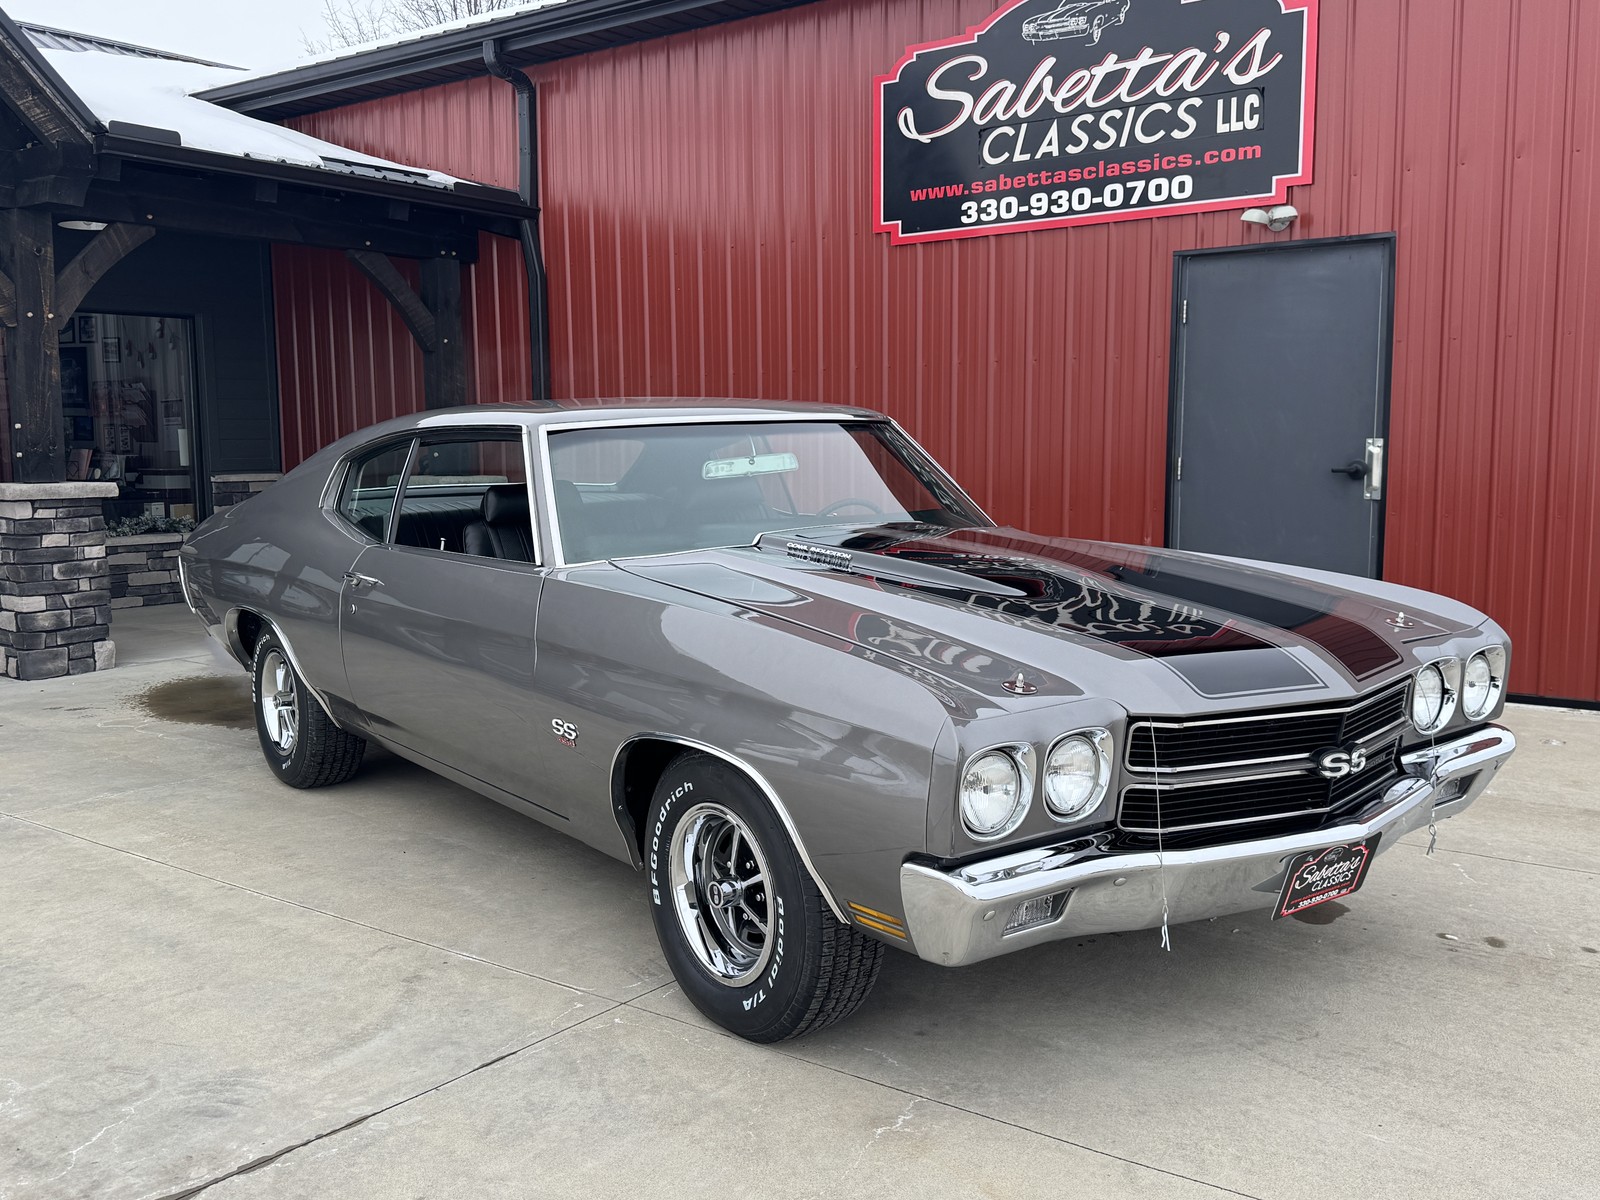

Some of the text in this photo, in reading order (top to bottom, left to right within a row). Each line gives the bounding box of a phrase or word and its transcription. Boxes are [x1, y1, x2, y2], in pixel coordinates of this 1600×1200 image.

[898, 27, 1284, 143] Sabetta's
[982, 93, 1261, 165] CLASSICS LLC
[910, 144, 1262, 202] www.sabettasclassics.com
[960, 174, 1193, 224] 330-930-0700
[786, 542, 851, 558] COWL INDUCTION
[551, 718, 577, 740] SS
[1320, 748, 1367, 778] SS
[651, 781, 694, 906] BFGoodrich
[1294, 856, 1361, 890] Sabetta's
[1311, 870, 1355, 892] CLASSICS
[742, 989, 767, 1011] T/A
